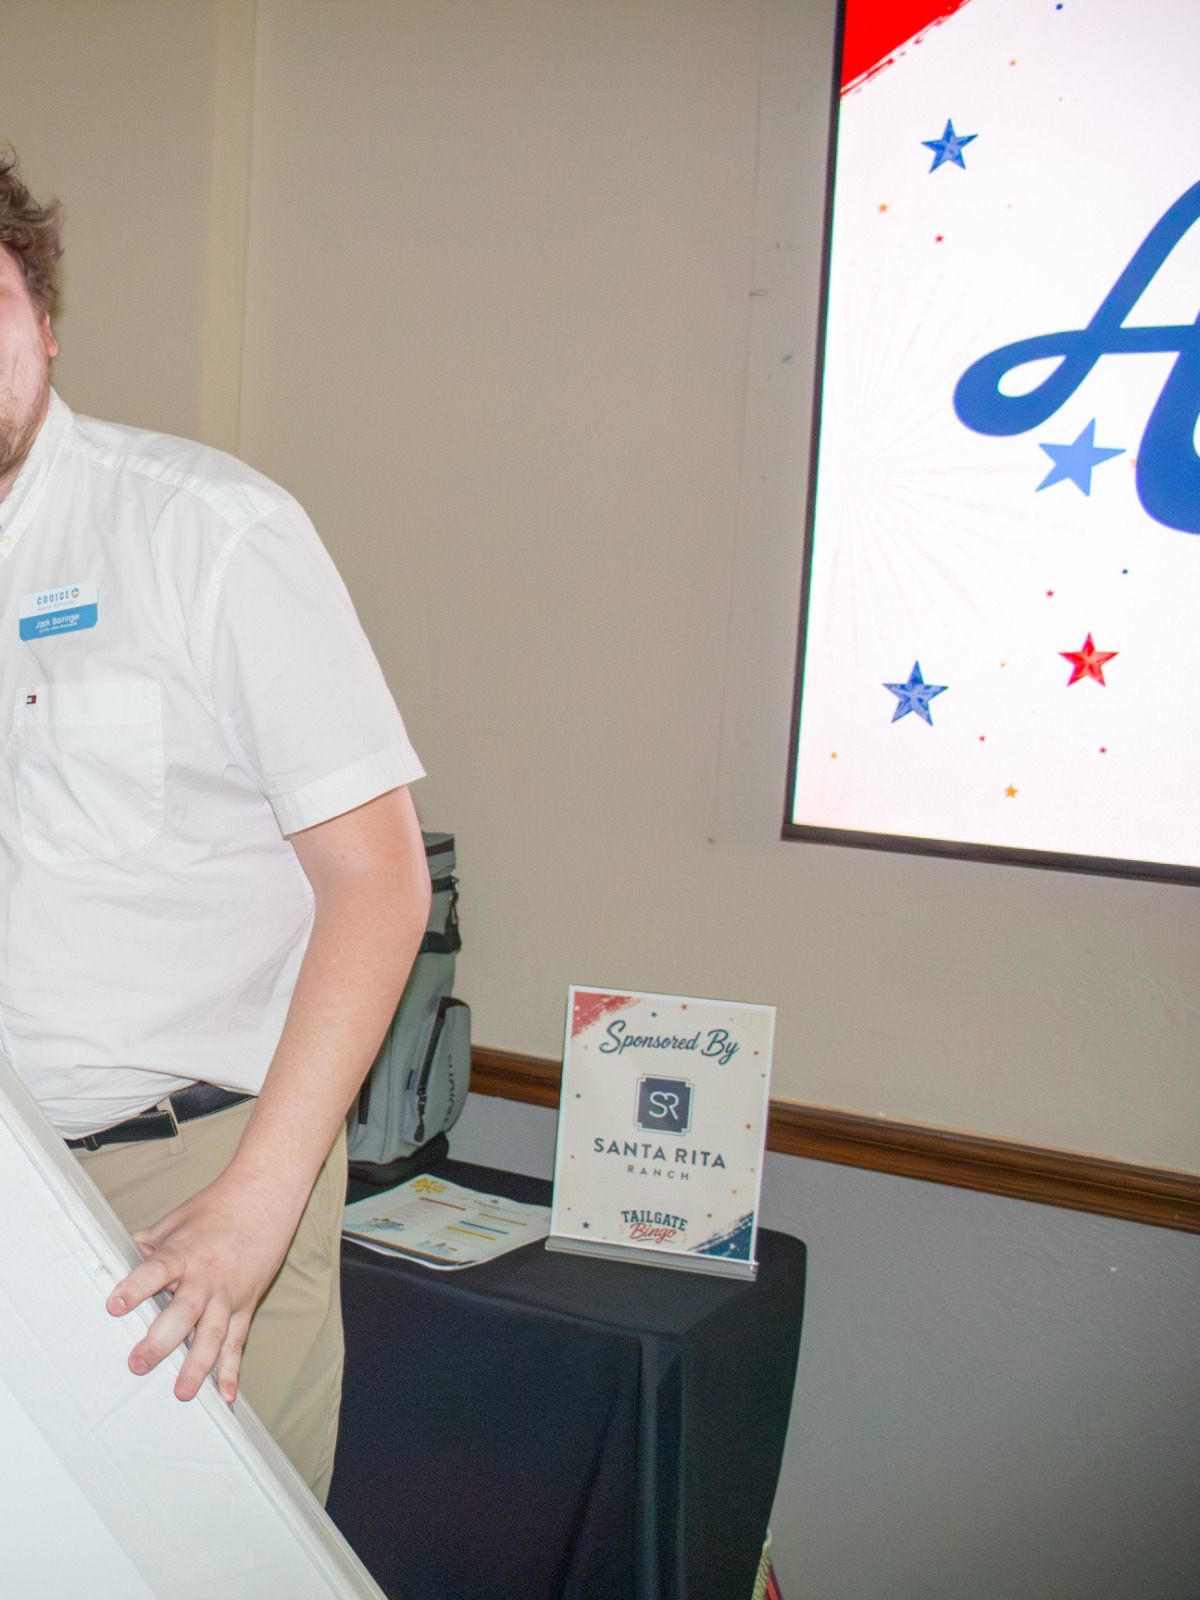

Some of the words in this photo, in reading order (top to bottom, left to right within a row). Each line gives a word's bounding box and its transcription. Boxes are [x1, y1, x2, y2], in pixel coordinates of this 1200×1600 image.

[36, 590, 70, 605] CHOICE
[599, 1019, 701, 1055] Sponsored
[701, 1028, 740, 1066] By
[648, 1090, 679, 1120] SR
[593, 1137, 667, 1161] SANTA
[675, 1148, 727, 1170] RITA
[627, 1165, 690, 1181] RANCH
[621, 1210, 688, 1232] TAILGATE
[629, 1222, 677, 1244] Bingo
